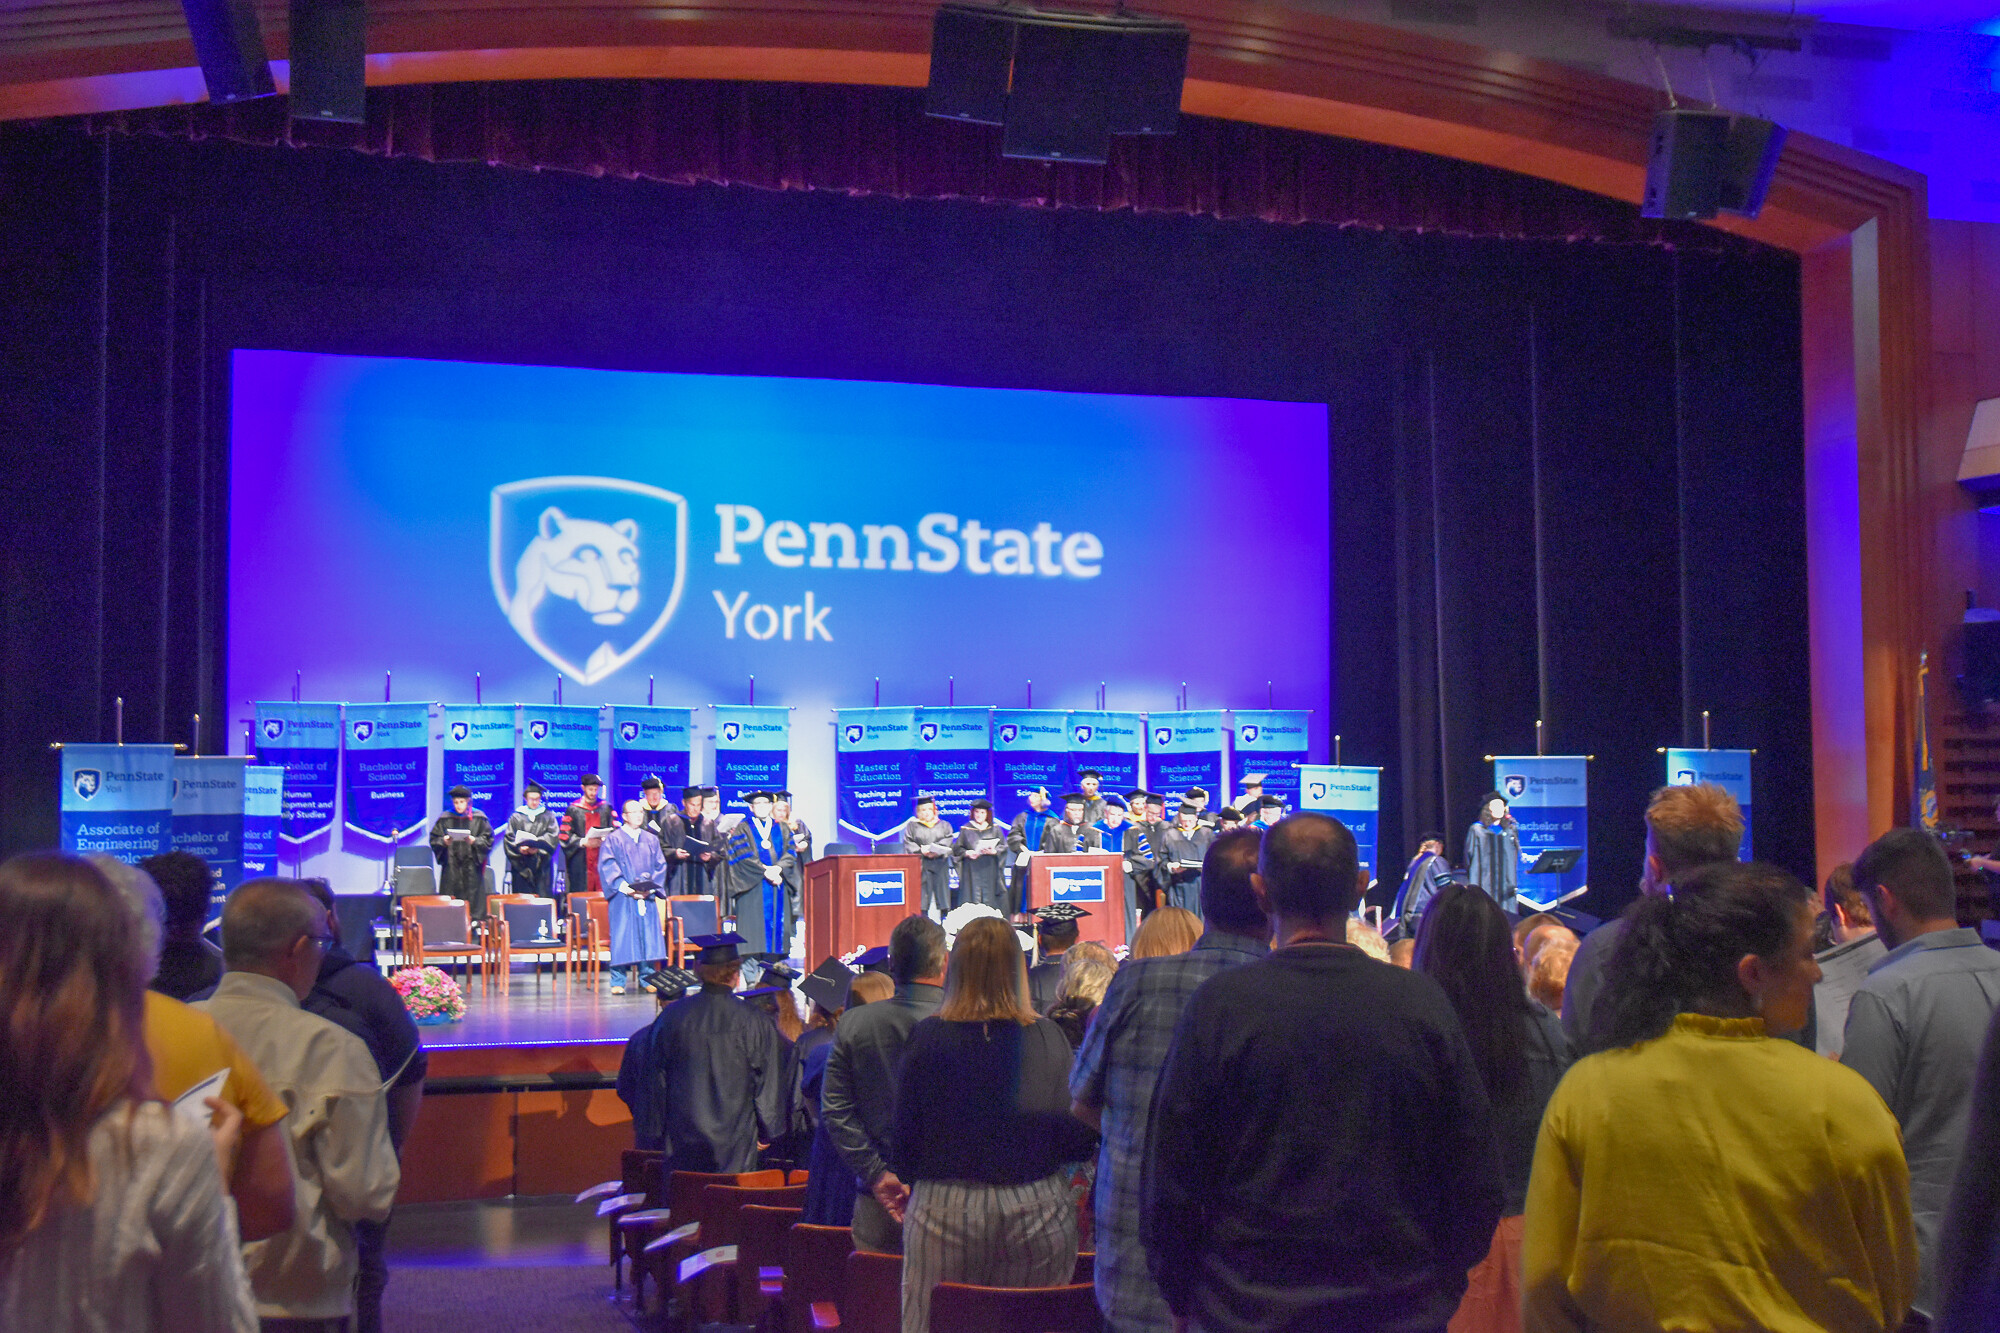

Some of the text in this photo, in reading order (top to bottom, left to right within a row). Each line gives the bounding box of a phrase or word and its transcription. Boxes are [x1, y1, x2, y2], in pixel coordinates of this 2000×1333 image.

[714, 503, 1104, 578] PennState
[712, 590, 834, 641] York
[287, 719, 334, 730] PennState
[376, 720, 423, 730] PennState
[471, 723, 509, 731] PennState
[551, 722, 593, 731] PennState
[642, 723, 685, 733] PennState
[743, 724, 783, 732] PennState
[866, 724, 909, 732] PennState
[941, 723, 983, 731] PennState
[1020, 725, 1062, 734] PennState
[1095, 726, 1134, 735] PennState
[1175, 727, 1215, 735] PennState
[1261, 726, 1303, 735] PennState
[316, 760, 328, 771] of
[359, 760, 417, 772] Bachelor of
[925, 762, 978, 771] Bachelor of
[1243, 757, 1288, 767] Associate
[455, 761, 504, 773] Bachelor of
[532, 762, 590, 772] Associate of
[625, 763, 679, 773] Bachelor of
[726, 762, 780, 772] Associate of
[855, 762, 901, 772] Master of
[1004, 763, 1057, 772] Bachelor of
[1121, 764, 1132, 773] of
[1160, 764, 1211, 774] Bachelor of
[105, 771, 164, 782] PennState
[285, 772, 318, 781] cience
[368, 772, 407, 782] Science
[463, 773, 496, 782] Science
[543, 772, 579, 782] Science
[735, 772, 769, 781] Science
[854, 773, 902, 782] Education
[933, 771, 969, 780] Science
[1012, 772, 1048, 781] Science
[1168, 773, 1203, 782] Science
[1244, 768, 1299, 778] Engineering
[182, 779, 237, 790] PennState
[1529, 776, 1579, 786] PennState
[105, 784, 122, 793] York
[1329, 783, 1372, 792] PennState
[284, 791, 313, 799] Human
[370, 791, 405, 800] Business
[854, 790, 902, 800] Teaching and
[918, 788, 986, 797] Electro-Mechanical
[317, 801, 334, 809] and
[858, 800, 898, 808] Curriculum
[296, 811, 327, 819] Studies
[76, 821, 160, 836] Associate of
[1356, 822, 1367, 831] of
[1562, 820, 1574, 831] of
[216, 830, 229, 842] of
[262, 829, 273, 839] of
[1530, 833, 1556, 842] Arts
[76, 837, 160, 852] Engineering
